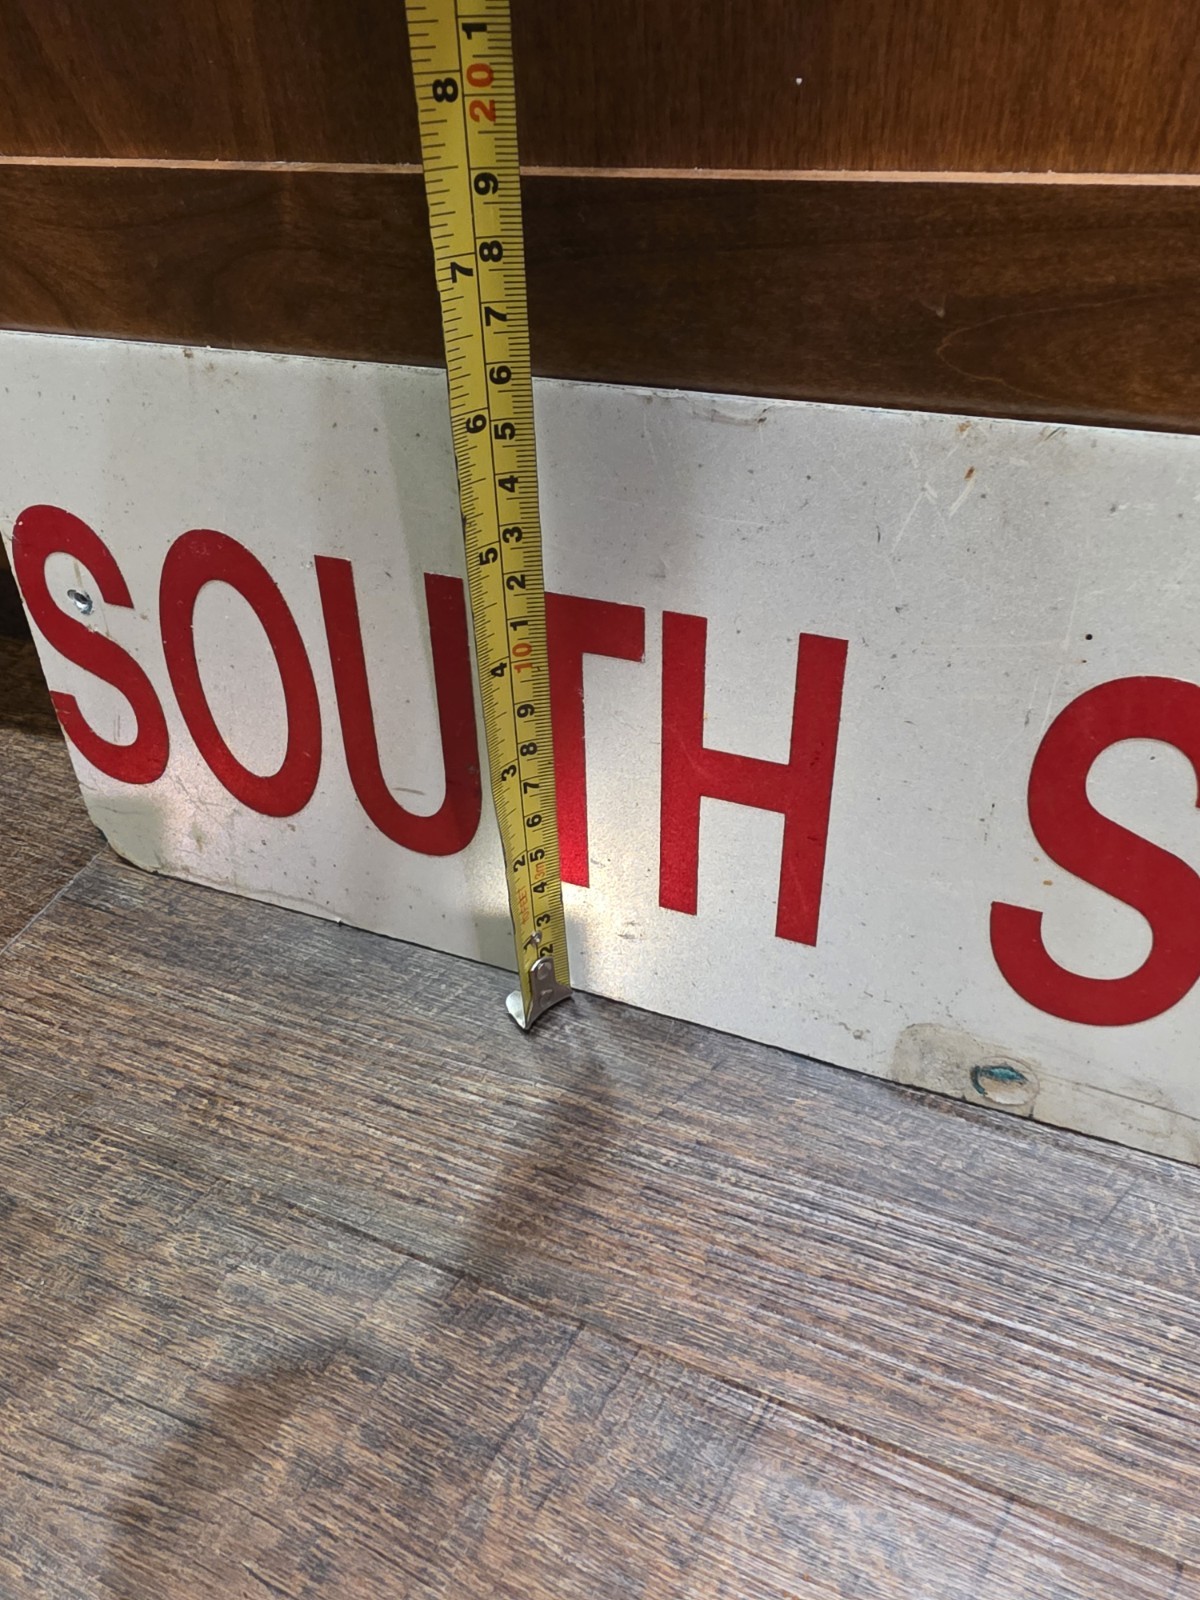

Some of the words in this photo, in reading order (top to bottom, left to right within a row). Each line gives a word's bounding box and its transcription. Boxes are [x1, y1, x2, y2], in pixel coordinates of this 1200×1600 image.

[461, 22, 488, 40] 1
[432, 77, 459, 103] 8
[466, 62, 497, 123] 20
[473, 172, 499, 196] 9
[479, 240, 504, 263] 8
[450, 261, 474, 283] 7
[484, 306, 508, 327] 7
[489, 365, 512, 385] 6
[466, 414, 487, 434] 6
[494, 422, 516, 440] 5
[498, 475, 519, 493] 4
[502, 526, 523, 543] 3
[478, 548, 498, 565] 5
[506, 573, 527, 591] 2
[510, 620, 529, 631] 1
[512, 642, 533, 673] 10
[490, 662, 507, 678] 4
[516, 703, 535, 718] 9
[12, 504, 849, 947] SOUTH
[520, 742, 538, 756] 8
[501, 764, 517, 782] 3
[523, 782, 540, 794] 7
[526, 814, 543, 828] 6
[513, 854, 526, 873] 2
[529, 848, 545, 862] 5
[532, 881, 548, 893] 4
[536, 913, 551, 927] 3
[539, 943, 554, 957] 2
